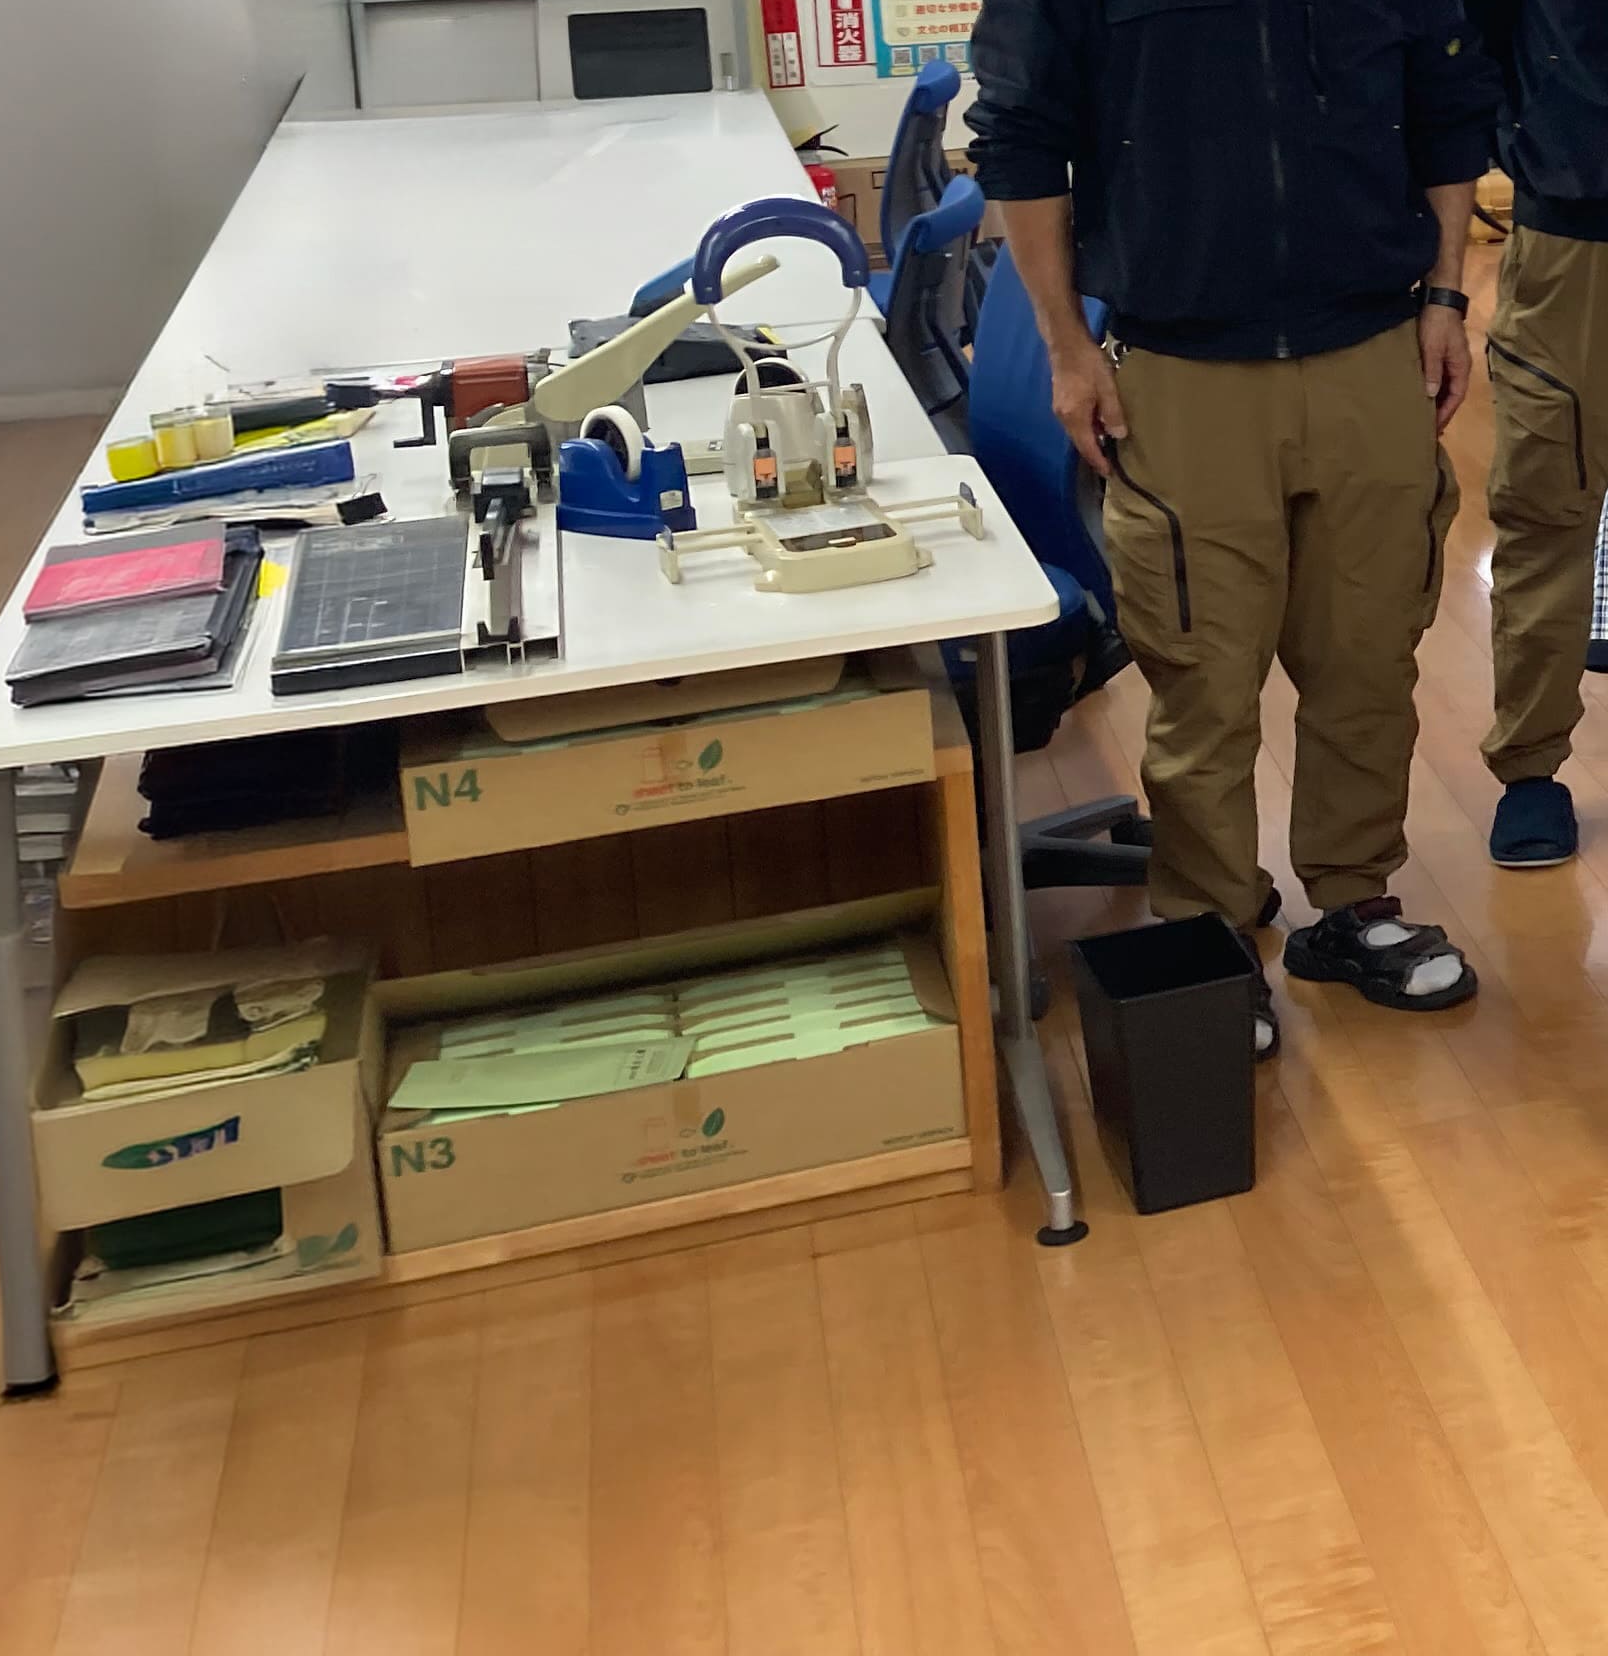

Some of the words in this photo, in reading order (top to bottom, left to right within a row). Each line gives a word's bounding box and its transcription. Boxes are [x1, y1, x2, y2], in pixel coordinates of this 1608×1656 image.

[834, 12, 862, 62] 消火器
[415, 769, 483, 811] N4
[391, 1137, 455, 1177] N3
